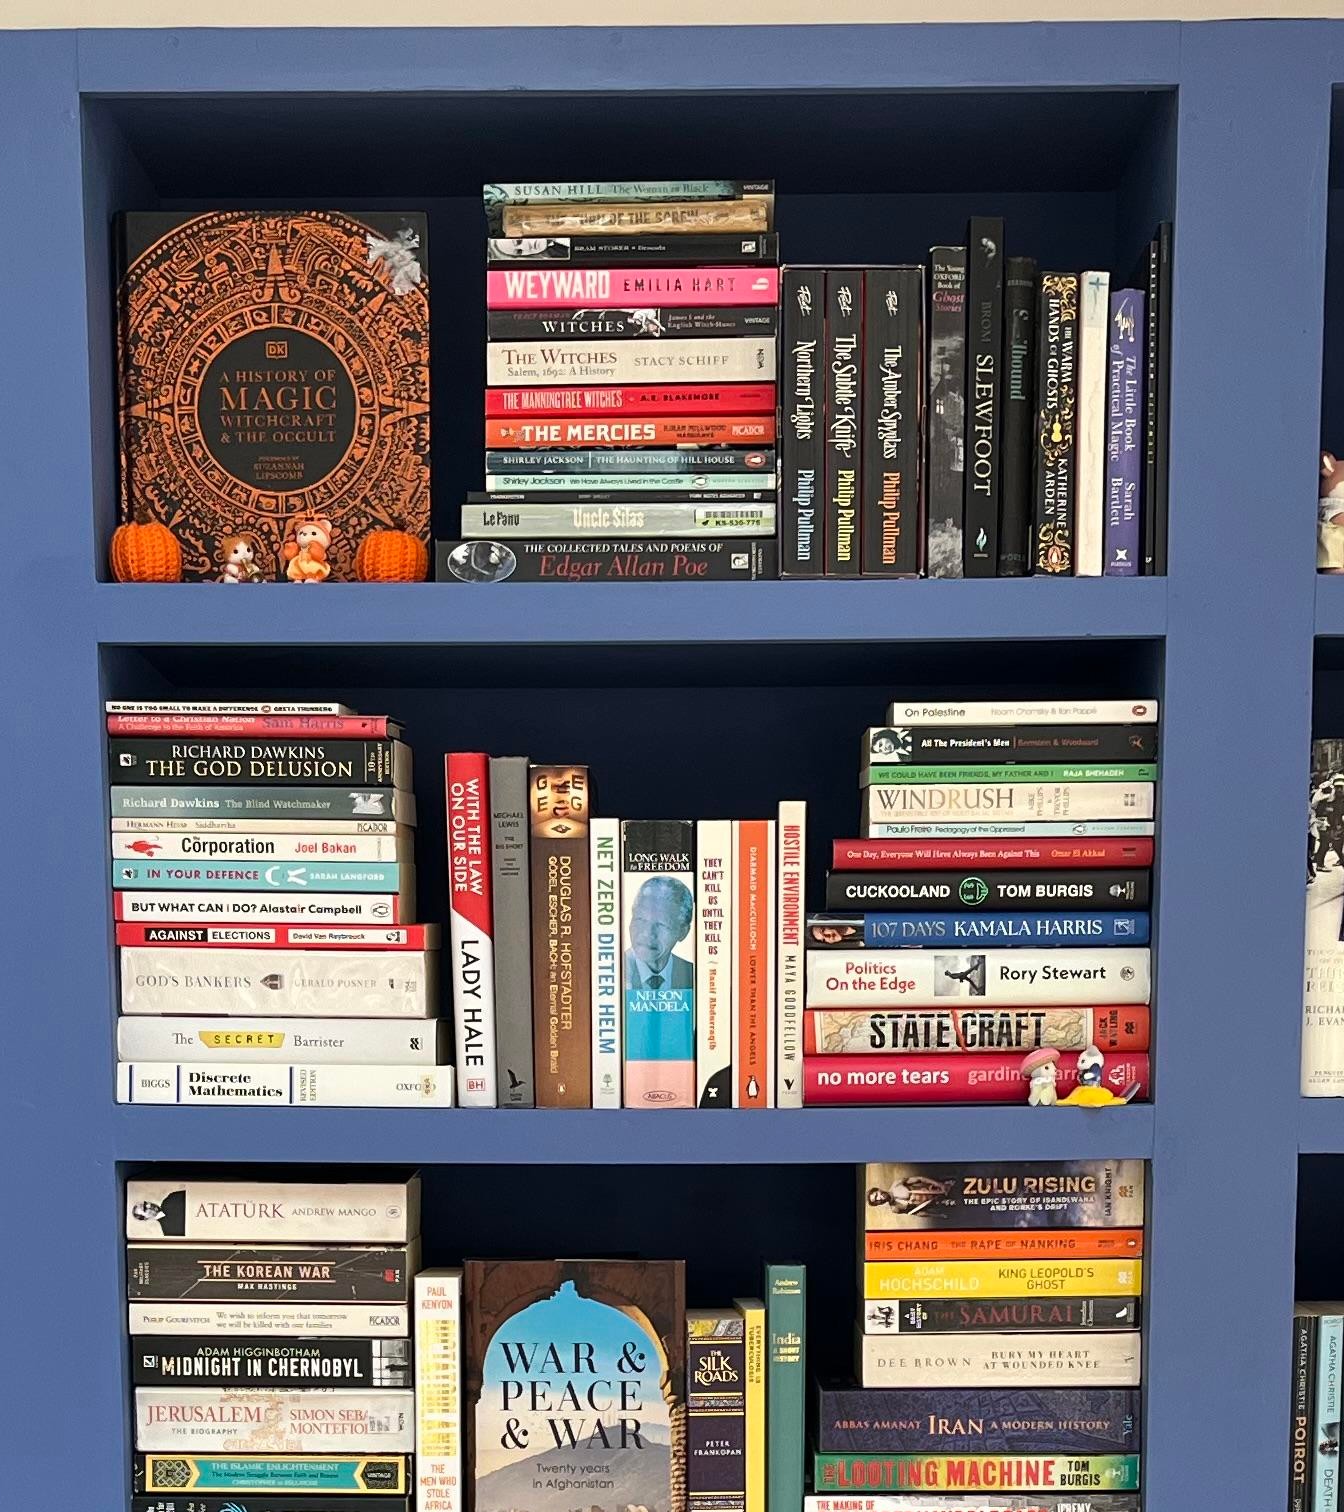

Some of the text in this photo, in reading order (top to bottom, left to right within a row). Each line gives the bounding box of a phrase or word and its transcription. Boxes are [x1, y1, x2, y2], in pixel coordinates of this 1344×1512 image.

[505, 270, 735, 300] WEYWARD EMILIA HART
[220, 370, 335, 384] A HISTORY OF
[221, 387, 336, 411] MAGIC
[974, 354, 994, 496] SLEWFOOT
[539, 556, 709, 581] Edgar Allan Poe
[172, 745, 325, 759] RICHARD DAWKINS
[146, 760, 353, 777] THE GOD DELUSION
[846, 883, 1093, 898] CUCKOOLAND TOM BURGIS
[149, 929, 271, 942] AGAINST ELECTIONS
[460, 939, 483, 1067] LADY HALE
[141, 1078, 171, 1089] BIGGS
[161, 1355, 363, 1378] MIDNIGHT IN CHERNOBYL
[499, 1342, 646, 1375] WAR &
[499, 1380, 644, 1412] PEACE
[500, 1418, 644, 1450] & WAR
